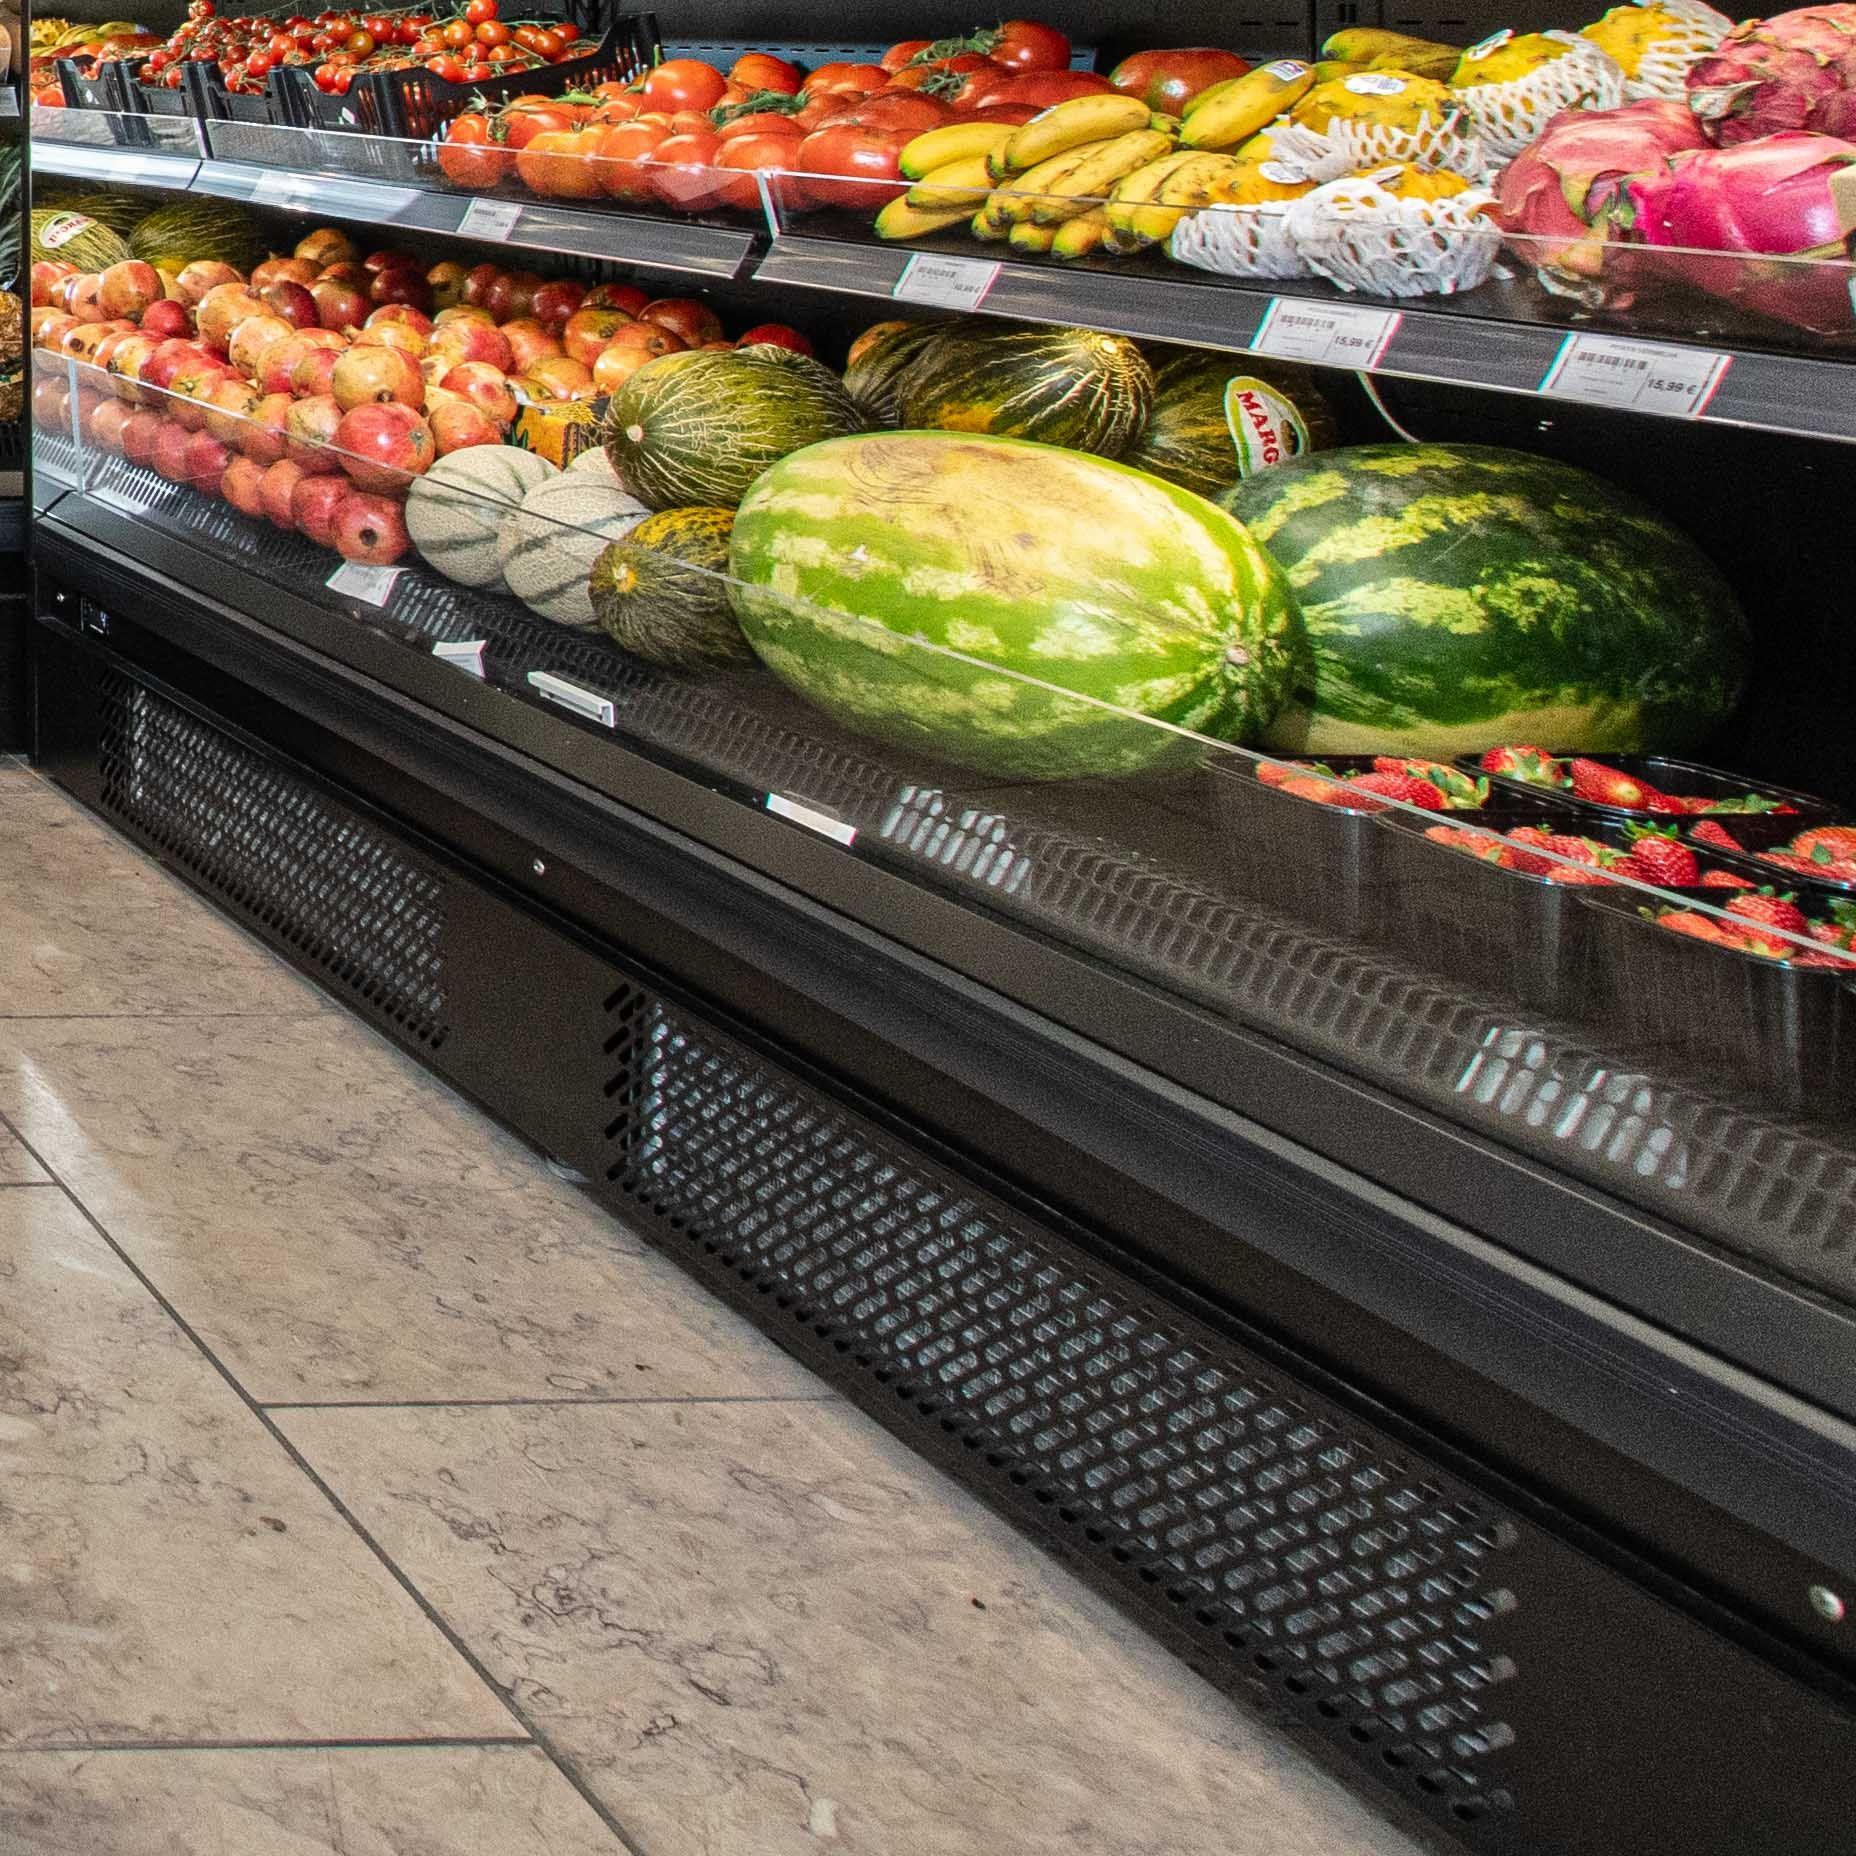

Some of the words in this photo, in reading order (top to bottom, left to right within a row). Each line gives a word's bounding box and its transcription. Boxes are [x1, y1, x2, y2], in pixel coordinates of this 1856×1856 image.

[1335, 335, 1363, 348] 15,99
[1365, 339, 1375, 349] €
[1648, 378, 1684, 393] 15,99
[1686, 384, 1697, 395] €
[1236, 391, 1281, 464] MARG
